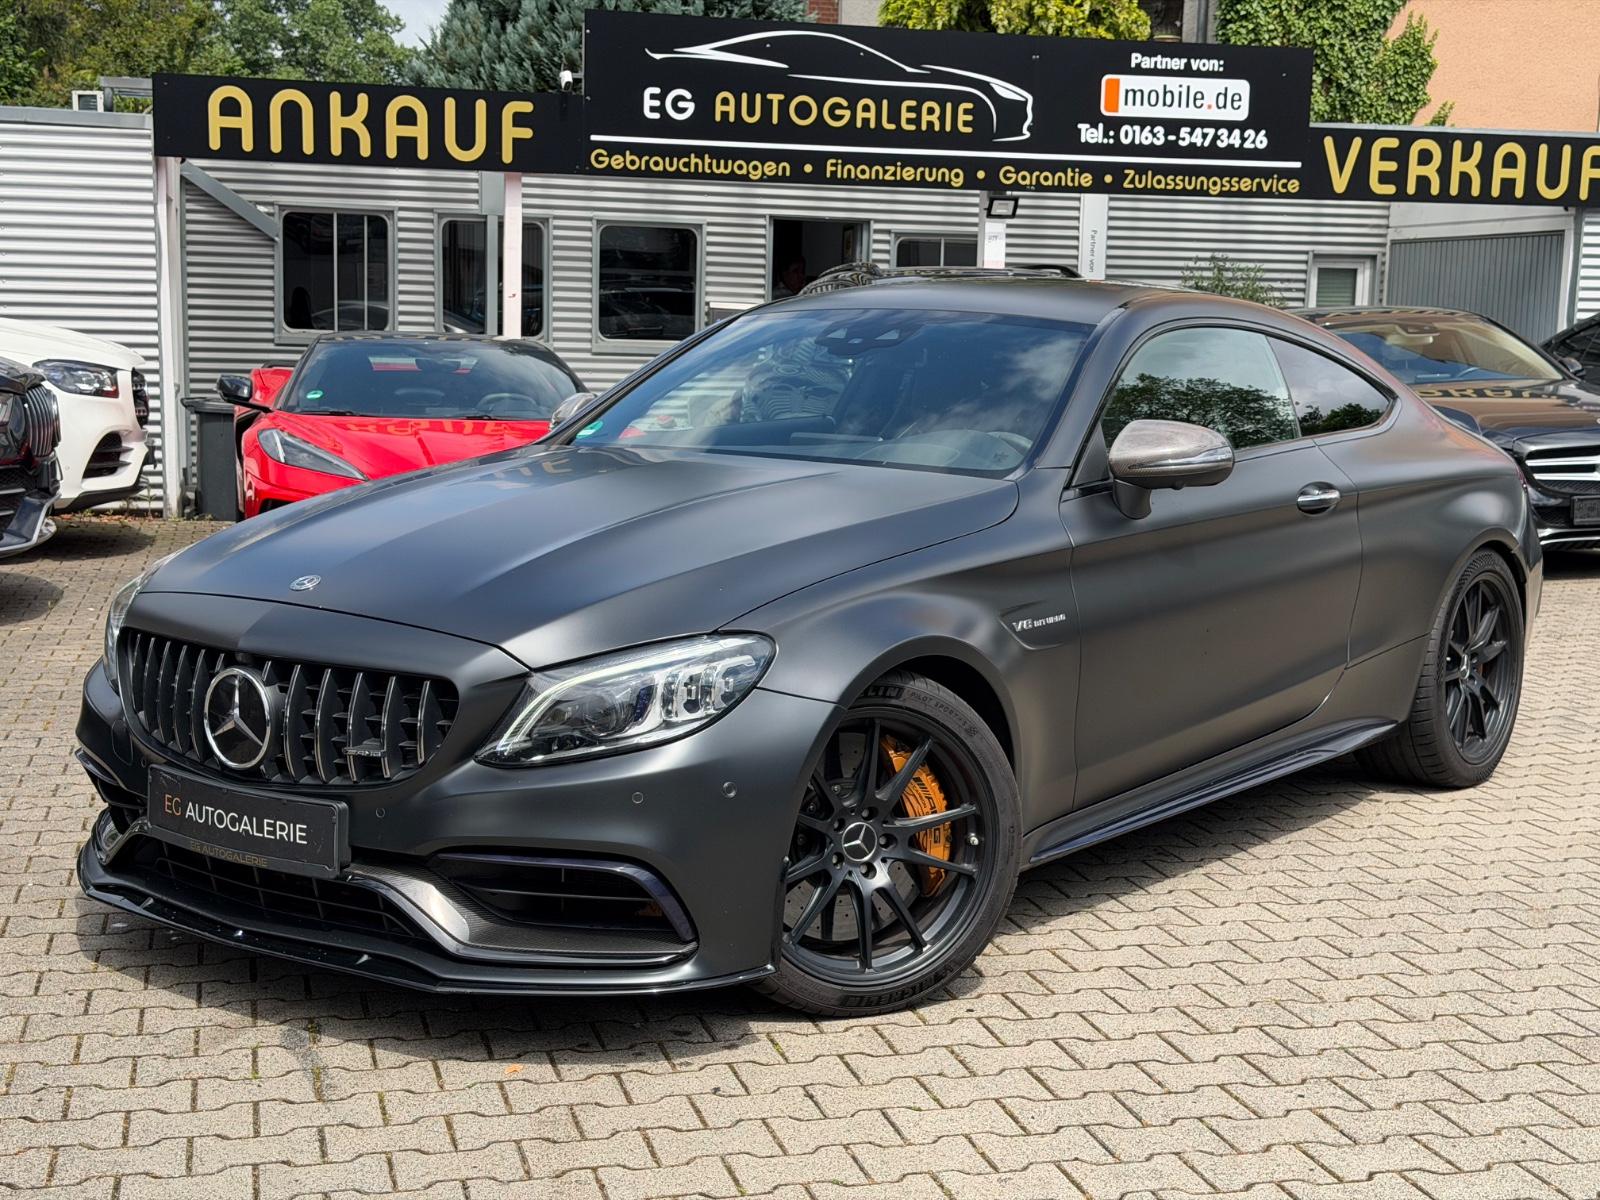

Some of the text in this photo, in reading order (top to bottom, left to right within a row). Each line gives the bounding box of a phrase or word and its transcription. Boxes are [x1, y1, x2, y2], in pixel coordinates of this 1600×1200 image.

[1130, 53, 1224, 72] Partner von:
[643, 87, 975, 134] EG AUTOGALERIE
[1124, 84, 1242, 111] mobile.de
[207, 85, 535, 165] ANKAUF
[1077, 123, 1115, 144] Tel.:
[590, 149, 1301, 196] Gebrauchtwagen Finanzierung Garantie Zulassungsservice
[1323, 135, 1600, 201] VERKAUF
[1088, 229, 1098, 273] Partner von
[164, 793, 308, 845] EG AUTOGALERIE
[203, 845, 269, 868] AUTOGALERIE
